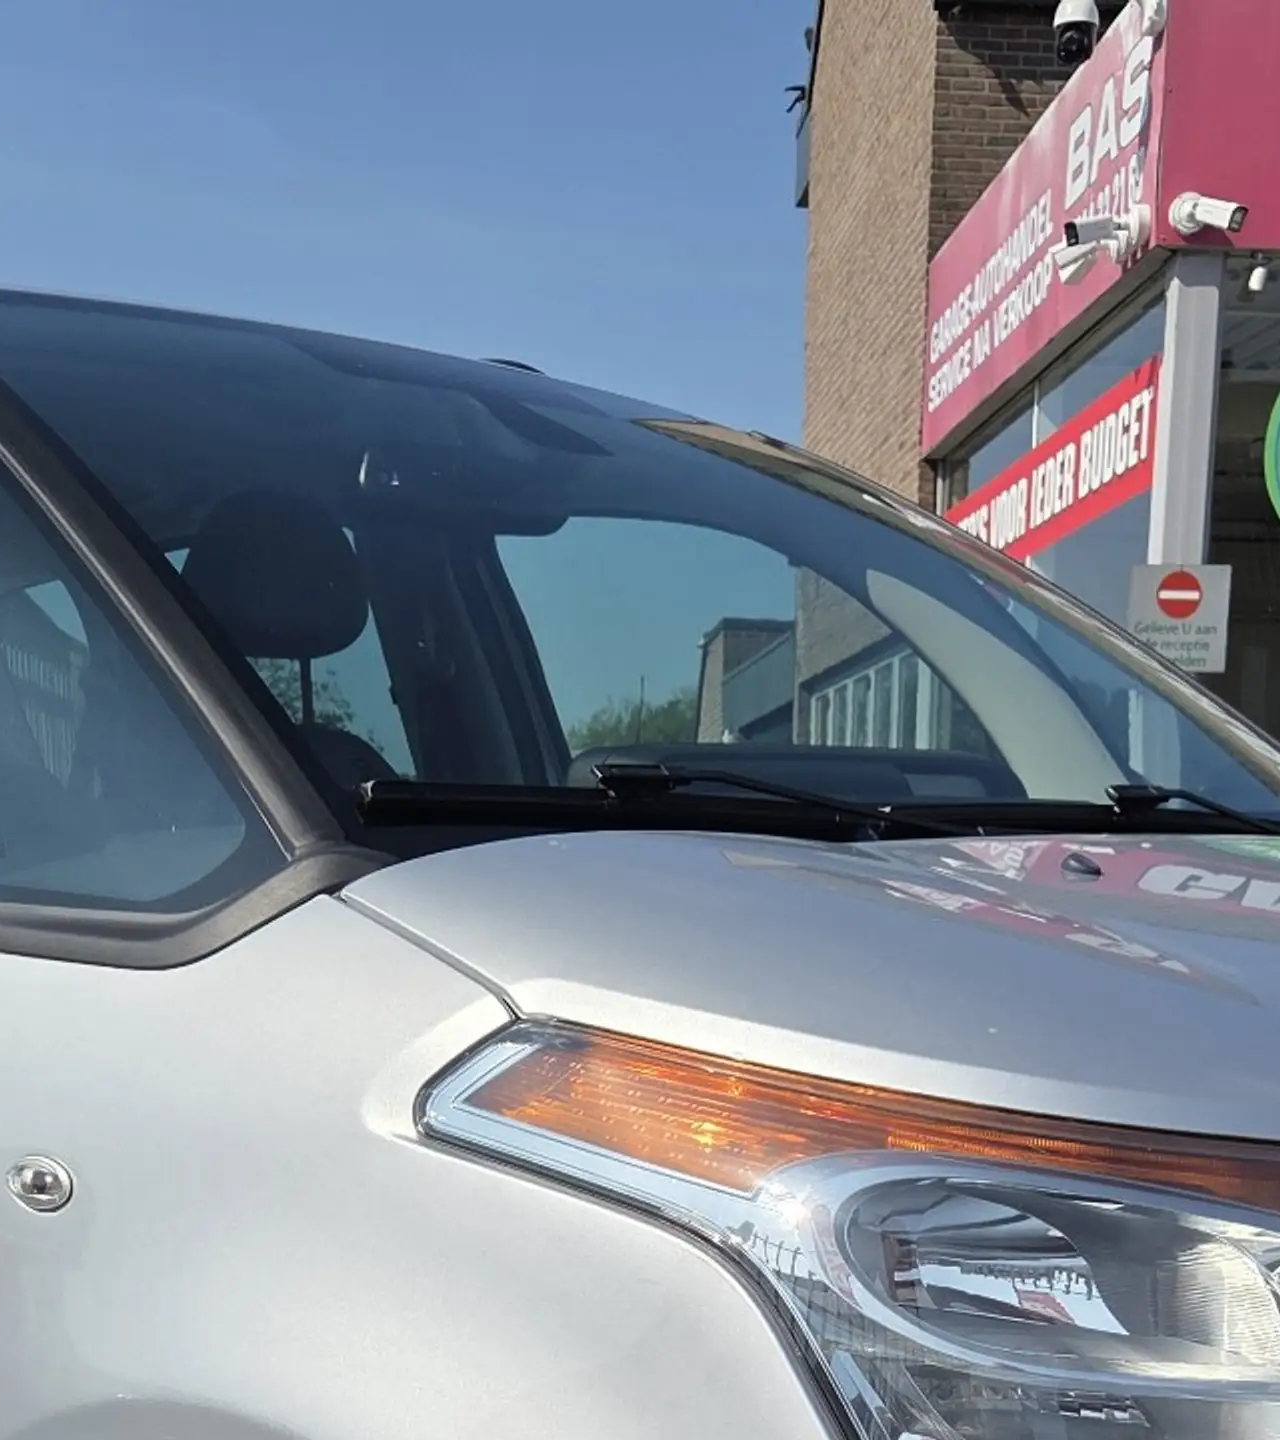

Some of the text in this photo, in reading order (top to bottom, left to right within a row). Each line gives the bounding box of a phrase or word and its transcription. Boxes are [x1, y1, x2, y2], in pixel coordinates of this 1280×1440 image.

[1064, 36, 1153, 210] BAS
[928, 252, 1053, 413] SERVICE NA VERKOOP
[989, 477, 1029, 550] VOOR
[1029, 441, 1077, 529] IEDER
[1078, 385, 1154, 499] BUDGET
